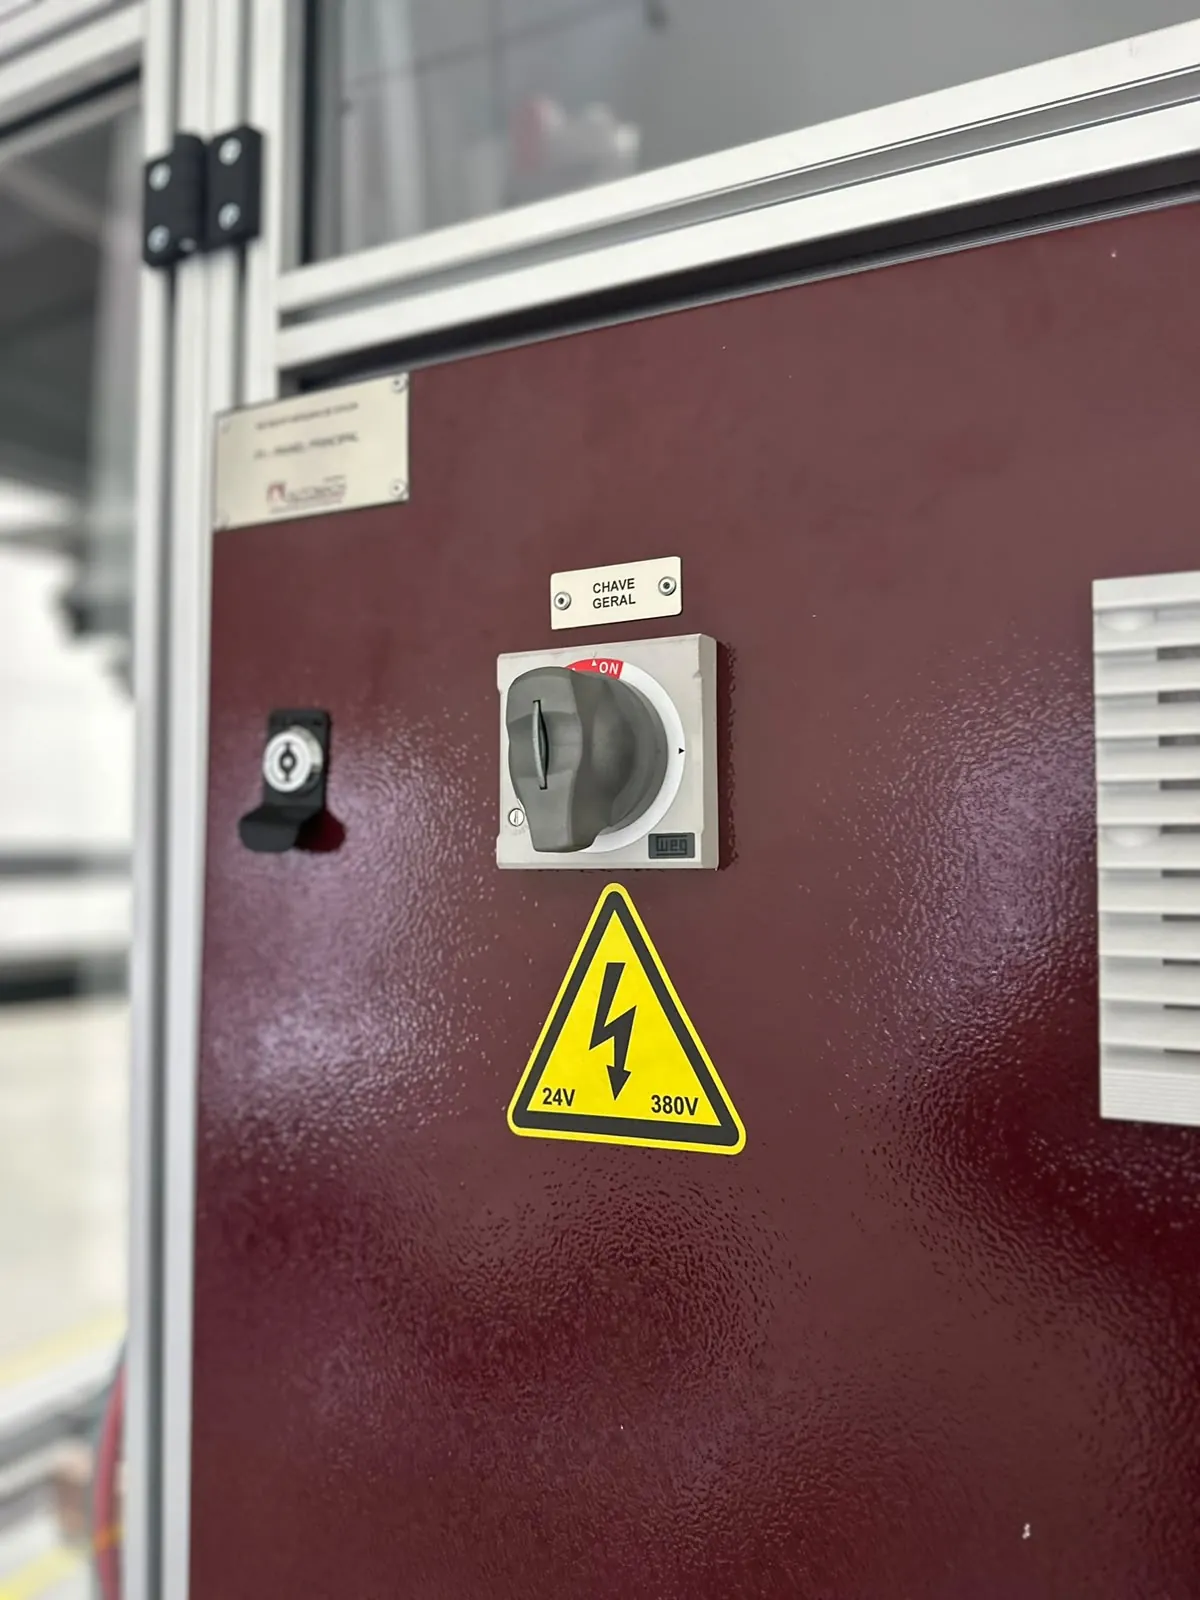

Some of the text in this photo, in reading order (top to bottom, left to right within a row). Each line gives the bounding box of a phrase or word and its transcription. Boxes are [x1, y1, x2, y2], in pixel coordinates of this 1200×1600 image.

[592, 577, 635, 594] CHAVE
[592, 593, 636, 609] GERAL
[599, 661, 619, 675] ON
[542, 1087, 576, 1107] 24V
[651, 1094, 699, 1116] 380V
